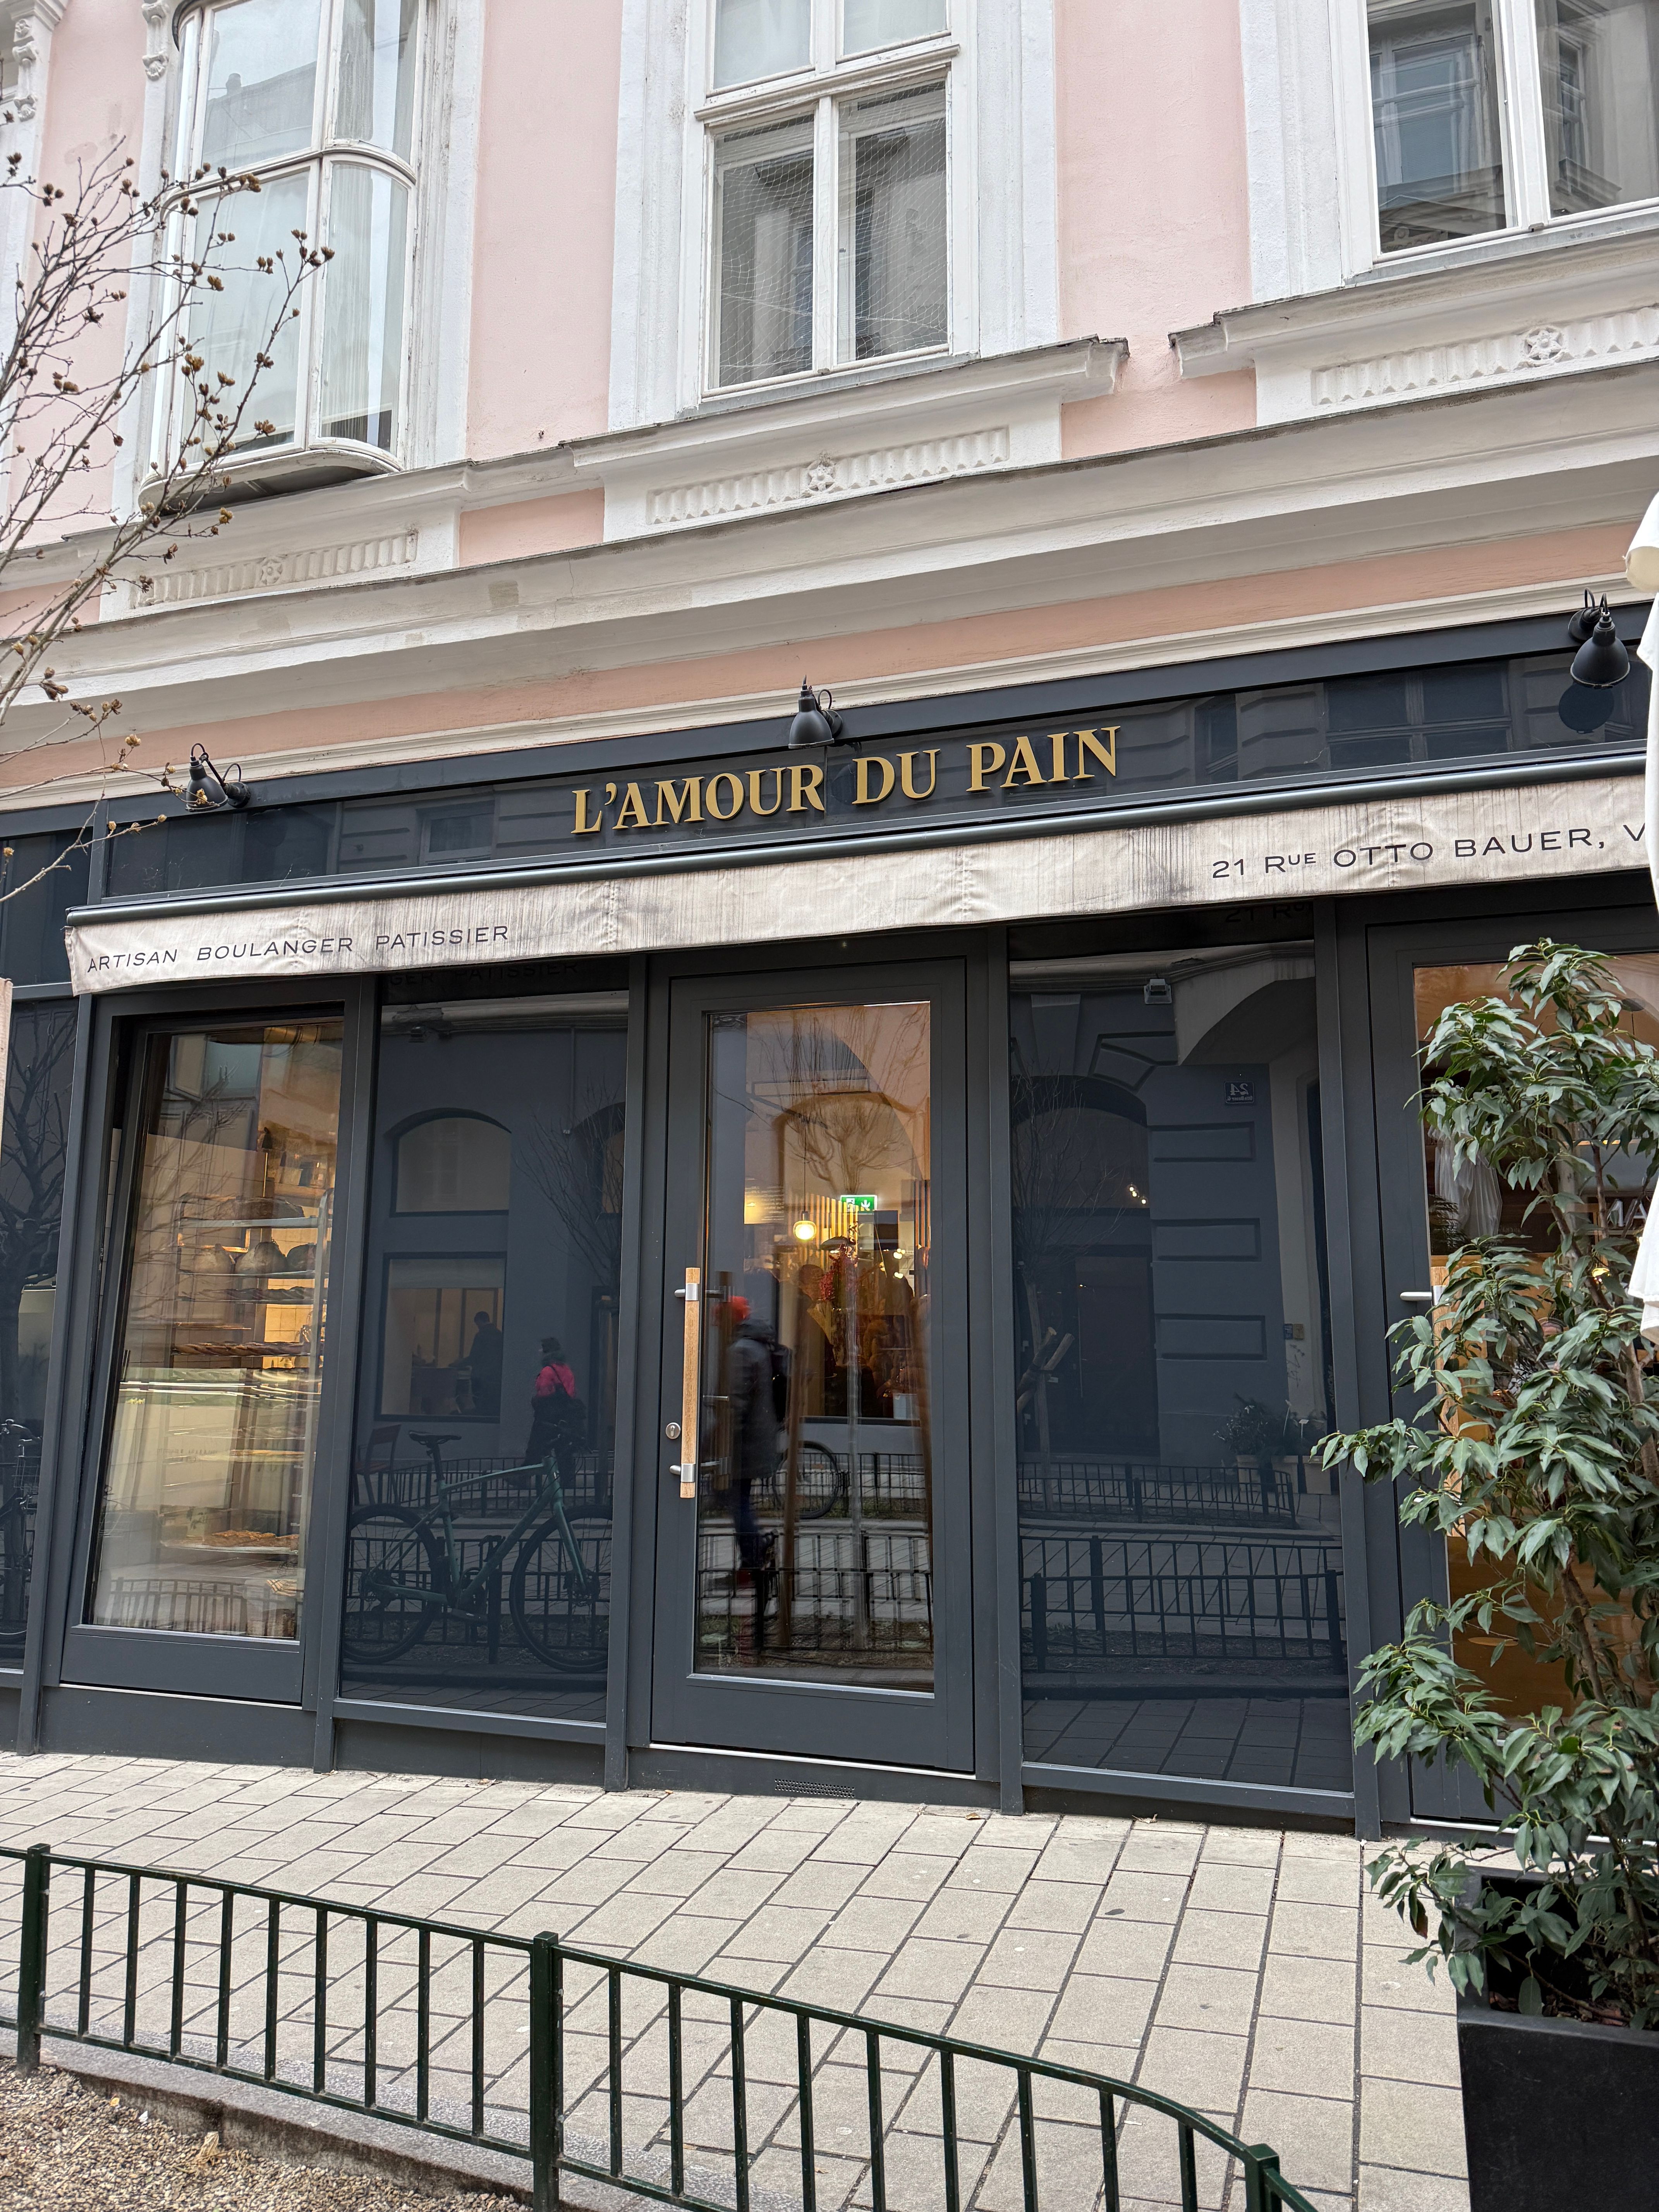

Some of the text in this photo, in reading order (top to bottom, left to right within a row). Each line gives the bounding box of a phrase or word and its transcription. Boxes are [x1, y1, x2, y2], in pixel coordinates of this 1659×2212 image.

[571, 726, 1121, 834] L'AMOUR DU PAIN
[1213, 859, 1244, 878] 21
[1334, 842, 1433, 867] OTTO
[1455, 829, 1604, 857] BAUER,
[87, 926, 508, 972] ARTISAN BOULANGER PATISSIER
